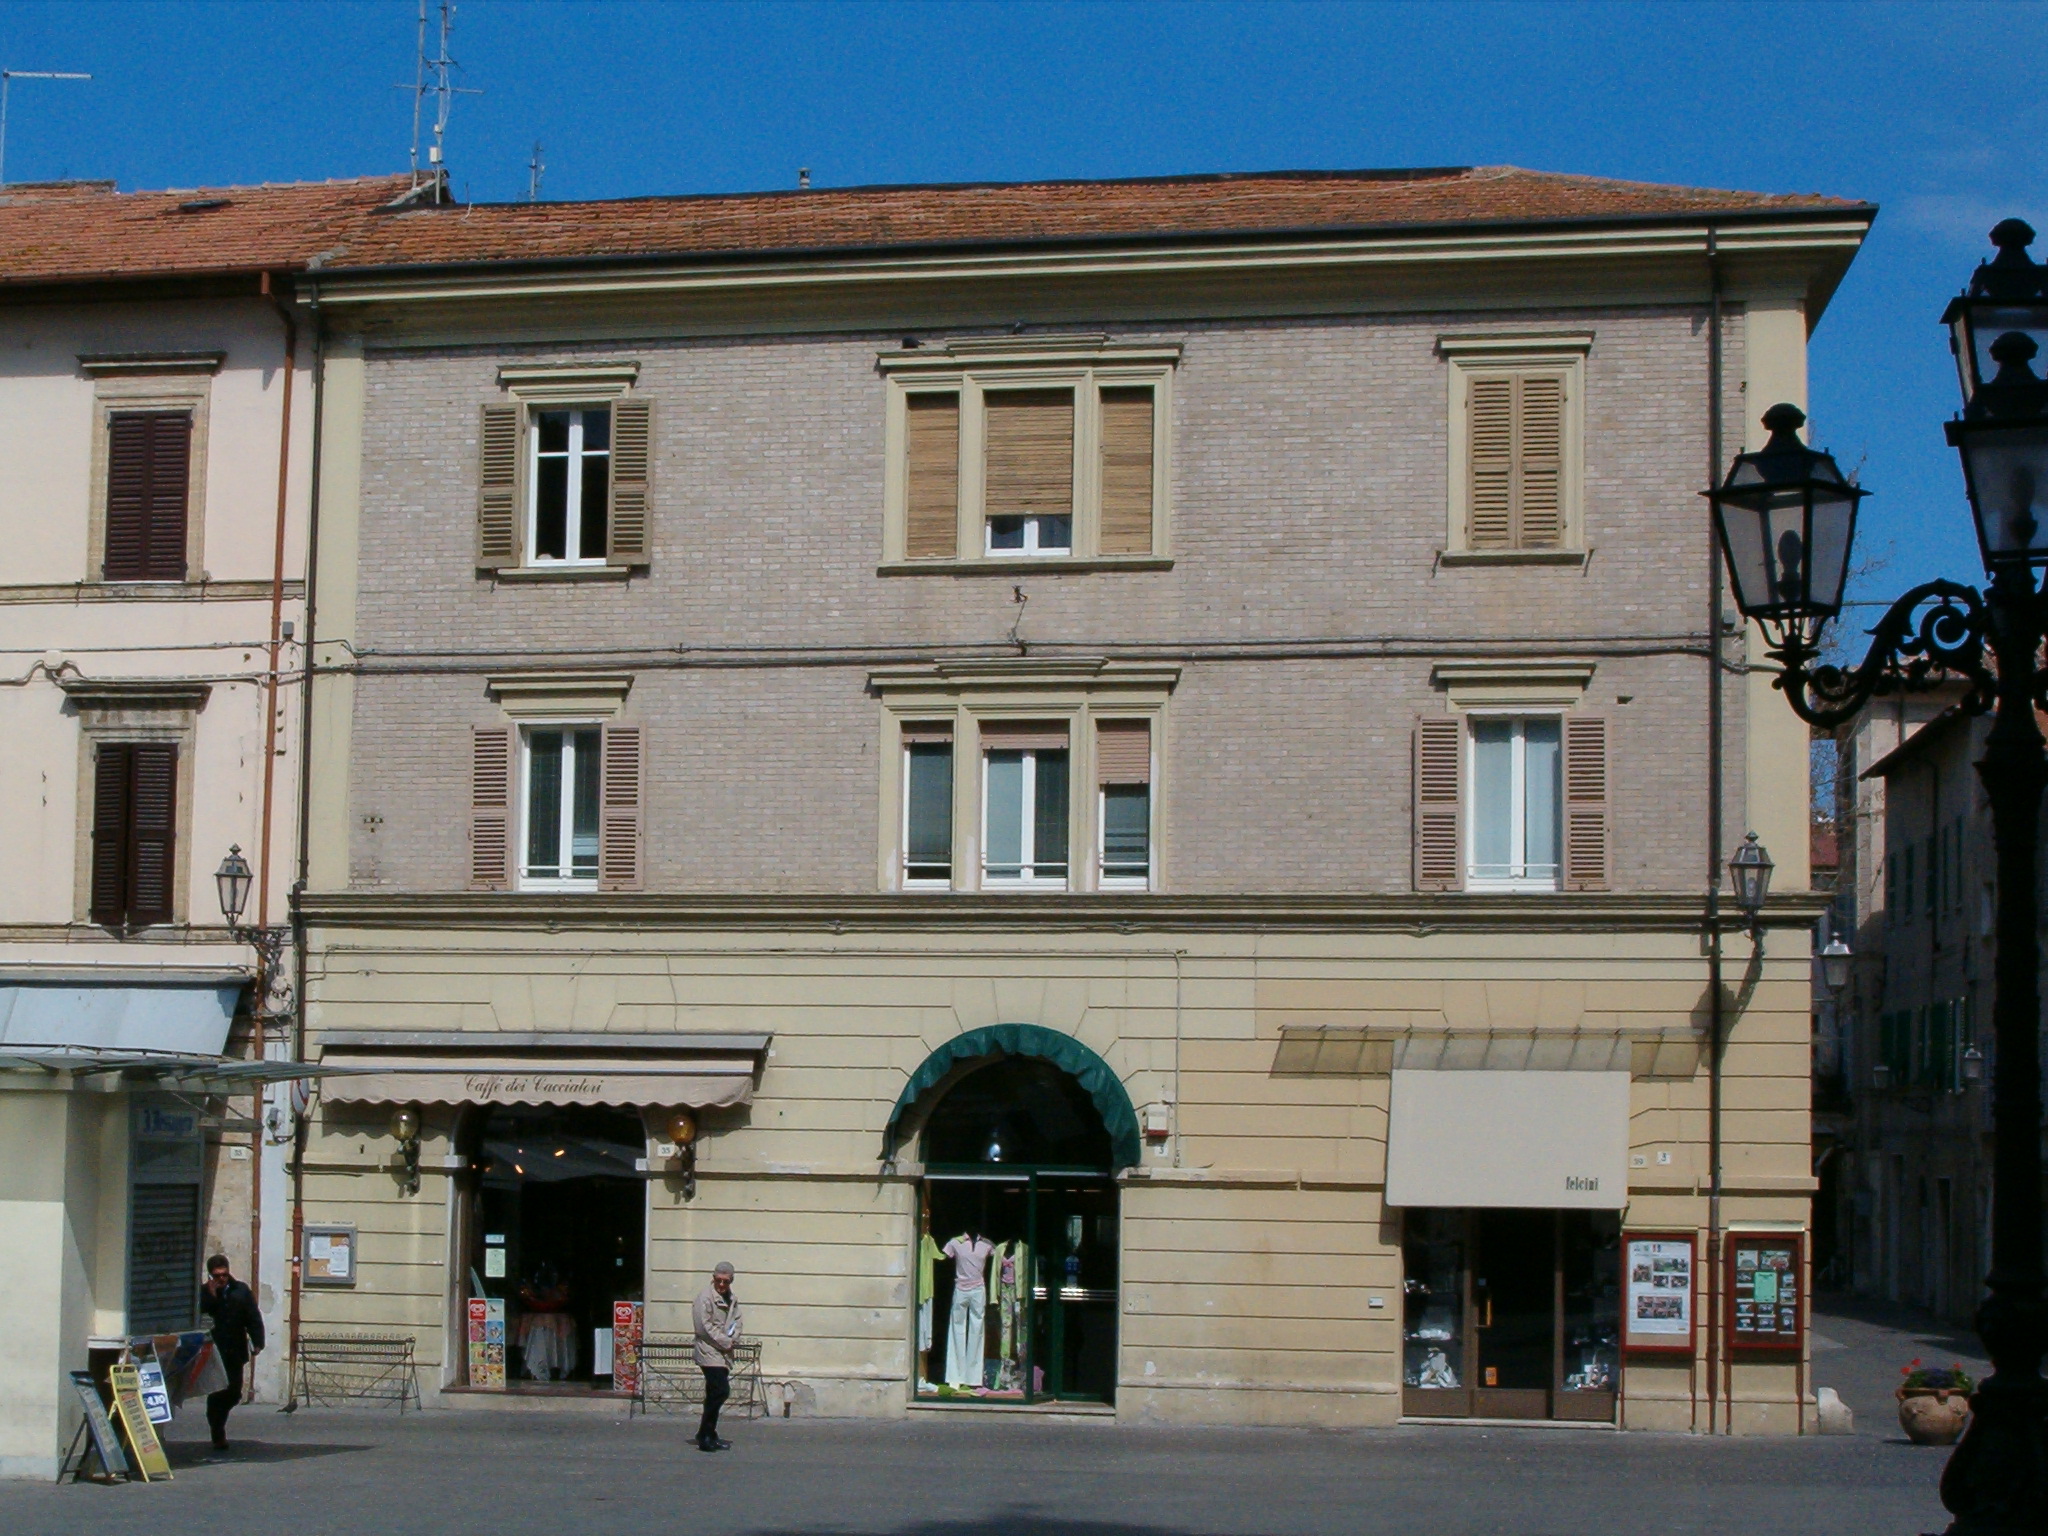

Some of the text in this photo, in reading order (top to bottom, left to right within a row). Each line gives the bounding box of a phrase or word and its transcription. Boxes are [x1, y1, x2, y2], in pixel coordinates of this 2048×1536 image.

[505, 1078, 528, 1092] dei
[533, 1075, 604, 1093] Cacciatori
[1566, 1176, 1598, 1191] felcini
